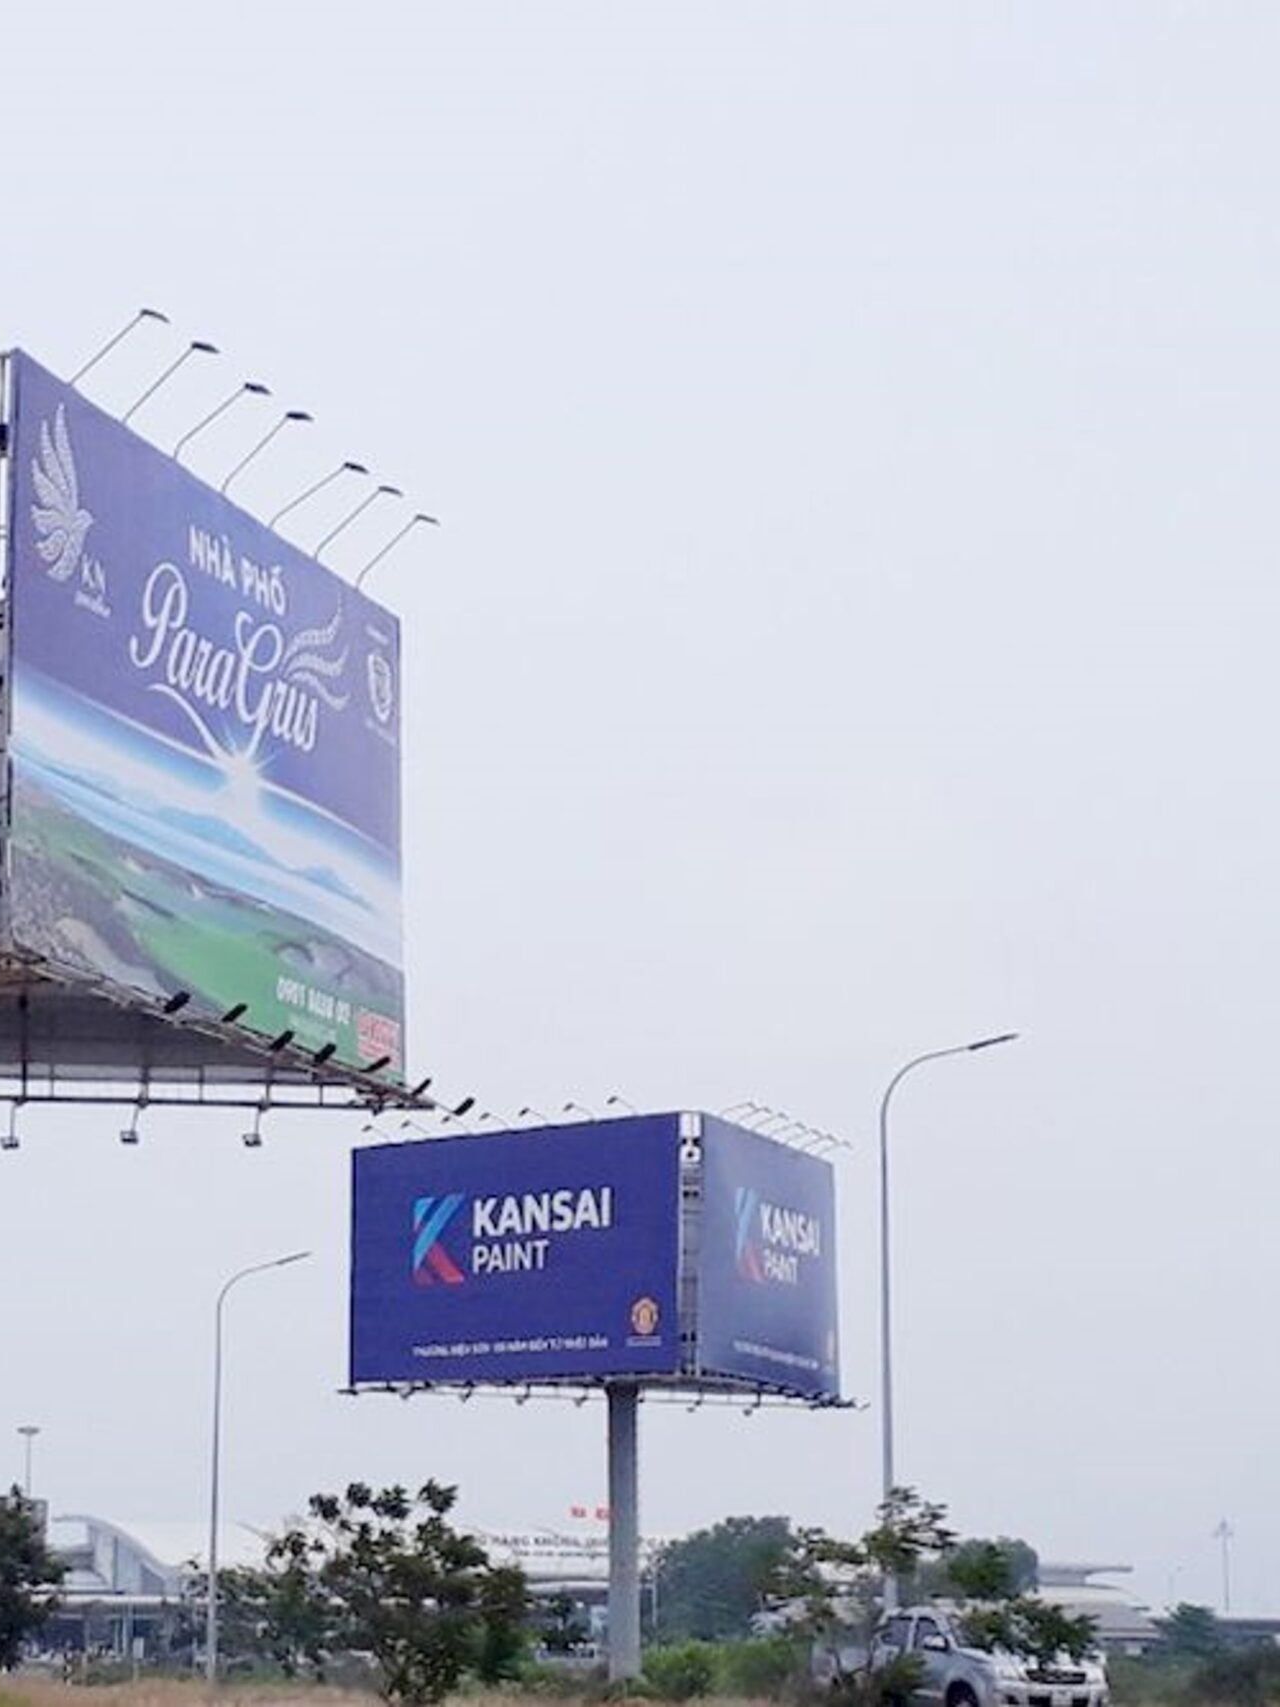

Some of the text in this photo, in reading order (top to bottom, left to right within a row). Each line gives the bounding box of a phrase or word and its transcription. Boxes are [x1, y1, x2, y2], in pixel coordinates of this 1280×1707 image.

[188, 525, 286, 617] NHÀ PHỐ
[130, 562, 319, 752] ParaGrus
[472, 1186, 612, 1238] KANSAI
[759, 1202, 821, 1257] KANSAI
[472, 1239, 550, 1274] PAINT
[763, 1248, 799, 1285] PAINT
